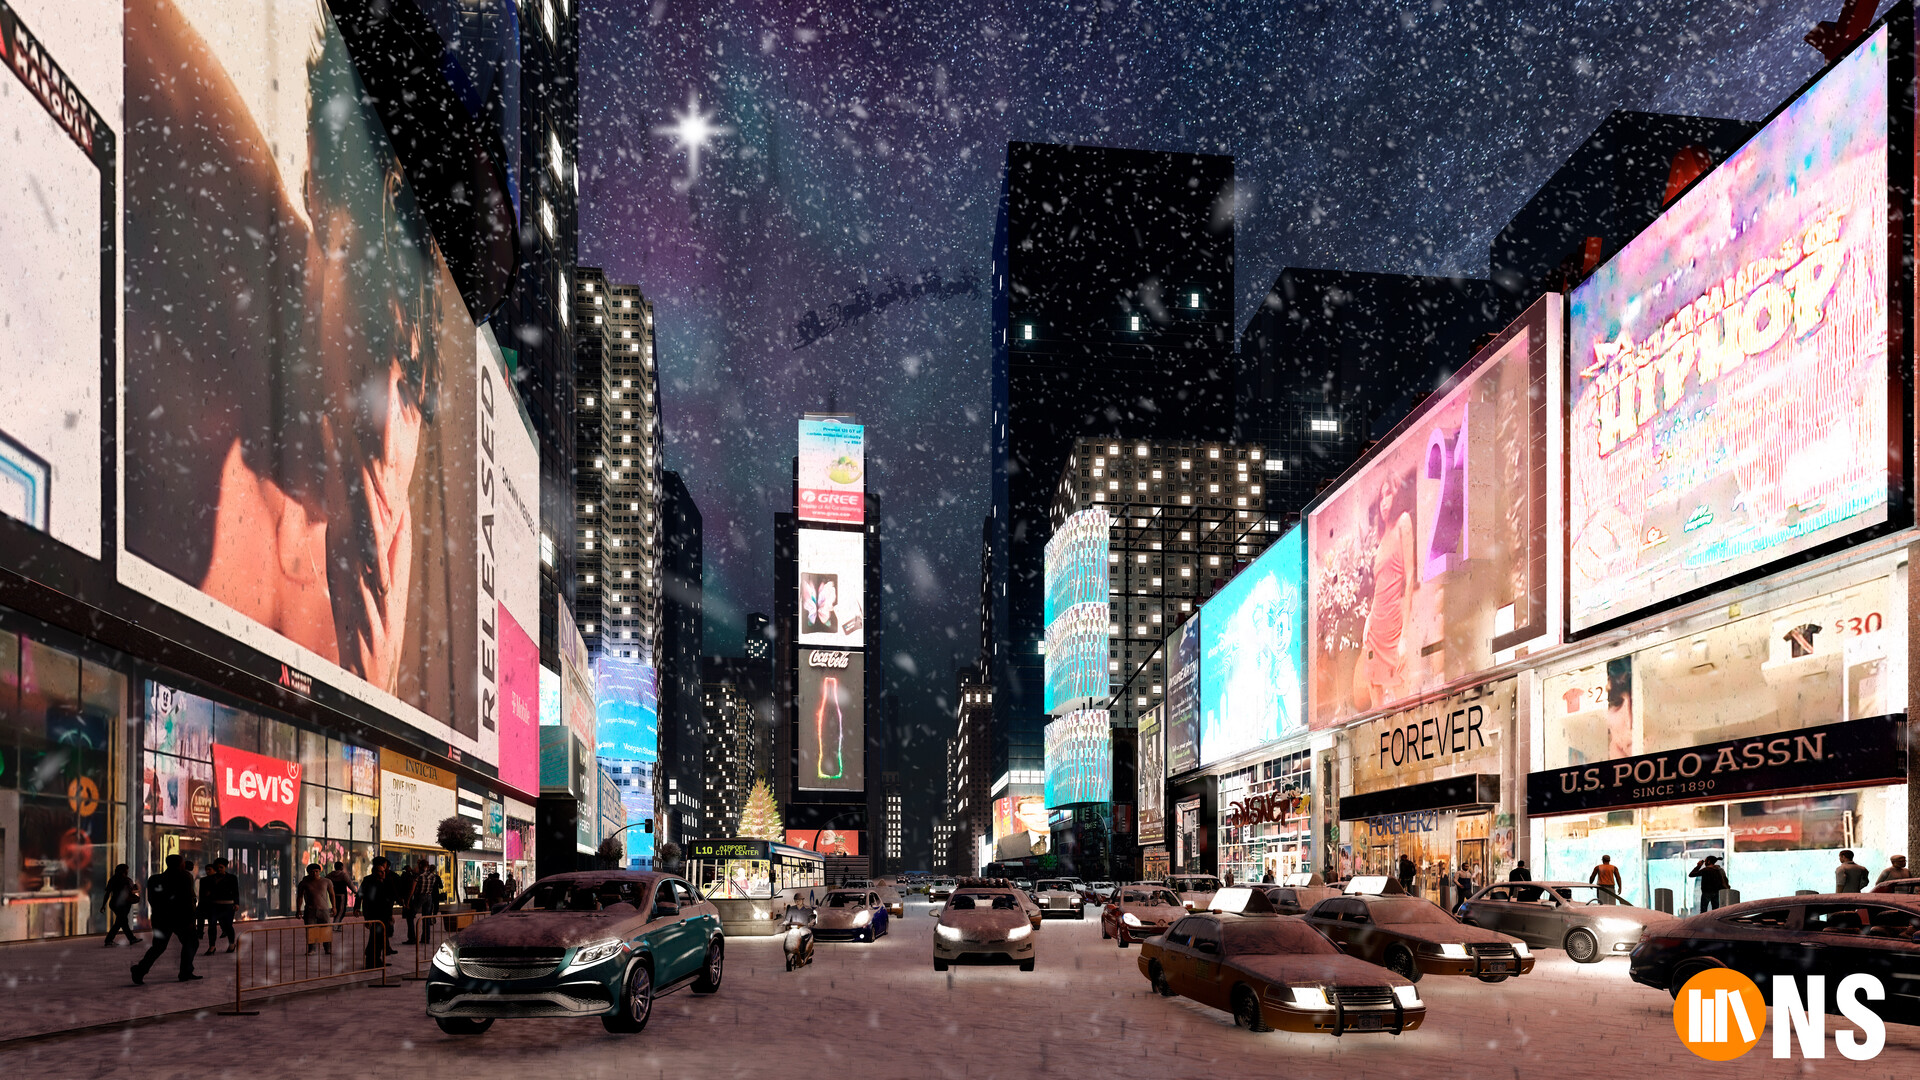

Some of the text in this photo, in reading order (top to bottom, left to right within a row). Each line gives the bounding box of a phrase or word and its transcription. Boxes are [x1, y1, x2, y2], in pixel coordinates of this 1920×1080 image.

[14, 22, 98, 132] MARRIOTT
[818, 493, 858, 505] GREE
[481, 365, 495, 732] RELEASED
[1587, 686, 1608, 703] $2
[1380, 704, 1485, 770] FOREVER
[405, 758, 438, 781] INVICTA
[1560, 732, 1835, 794] U.S. POLO ASSN.
[1633, 779, 1715, 798] SINCE 1890
[395, 823, 415, 839] DEALS
[695, 846, 713, 855] L10
